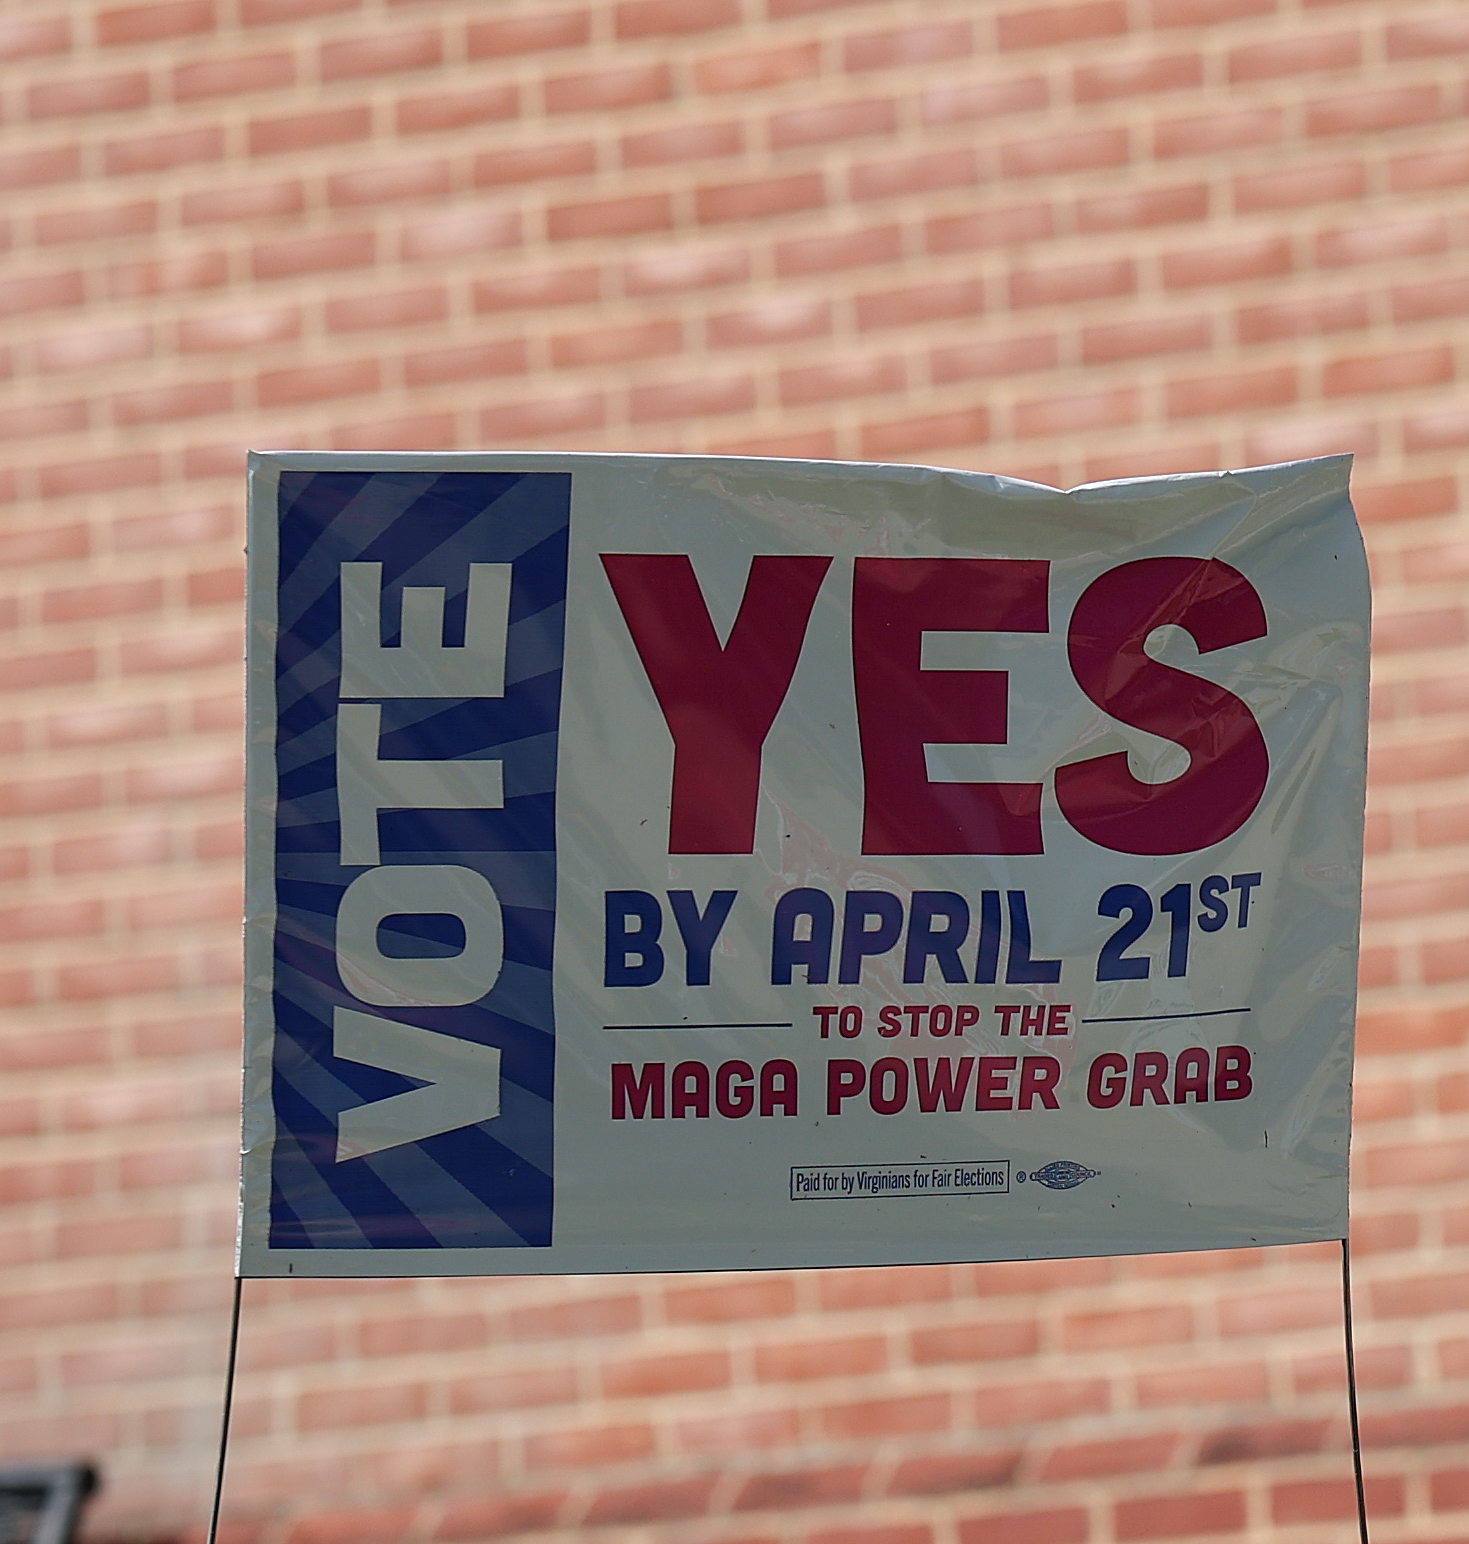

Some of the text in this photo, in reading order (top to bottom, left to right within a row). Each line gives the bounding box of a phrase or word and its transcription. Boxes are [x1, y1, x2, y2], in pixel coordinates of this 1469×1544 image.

[599, 553, 1269, 856] YES
[334, 561, 512, 1163] VOTE
[603, 872, 1262, 987] BY APRIL 21ST
[812, 1004, 1071, 1039] TO STOP THE
[610, 1045, 1254, 1120] MAGA POWER GRAB
[795, 1171, 820, 1192] Paid
[822, 1173, 839, 1191] for
[841, 1172, 855, 1194] by
[856, 1170, 910, 1194] Virginians
[913, 1169, 929, 1188] for
[932, 1168, 951, 1188] Fair
[954, 1167, 1004, 1188] Elections
